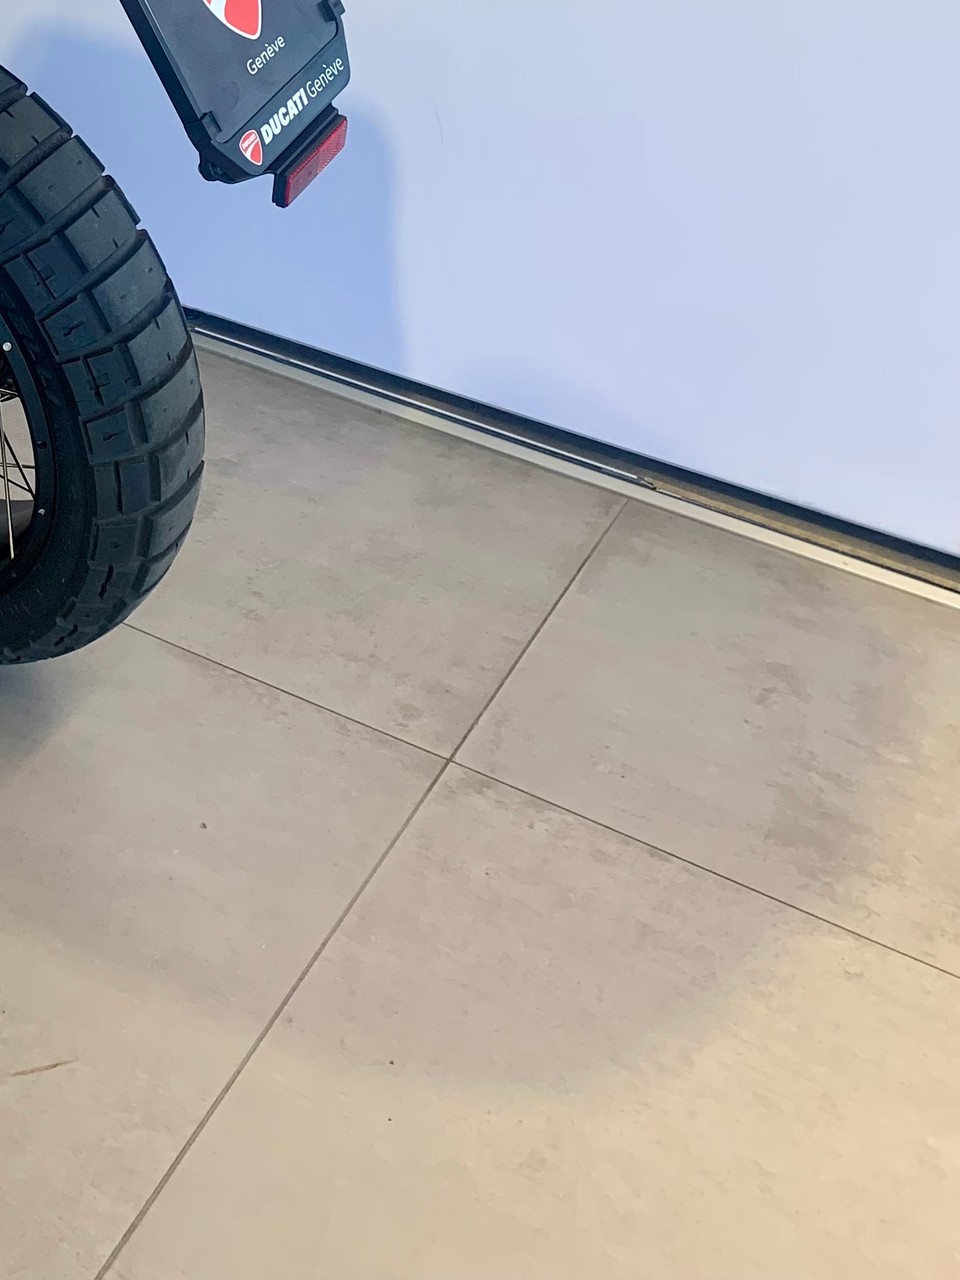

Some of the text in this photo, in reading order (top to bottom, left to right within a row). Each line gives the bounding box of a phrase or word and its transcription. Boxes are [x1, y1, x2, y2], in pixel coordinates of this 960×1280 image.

[246, 36, 286, 75] Genève
[260, 58, 344, 145] DUCATI Genève
